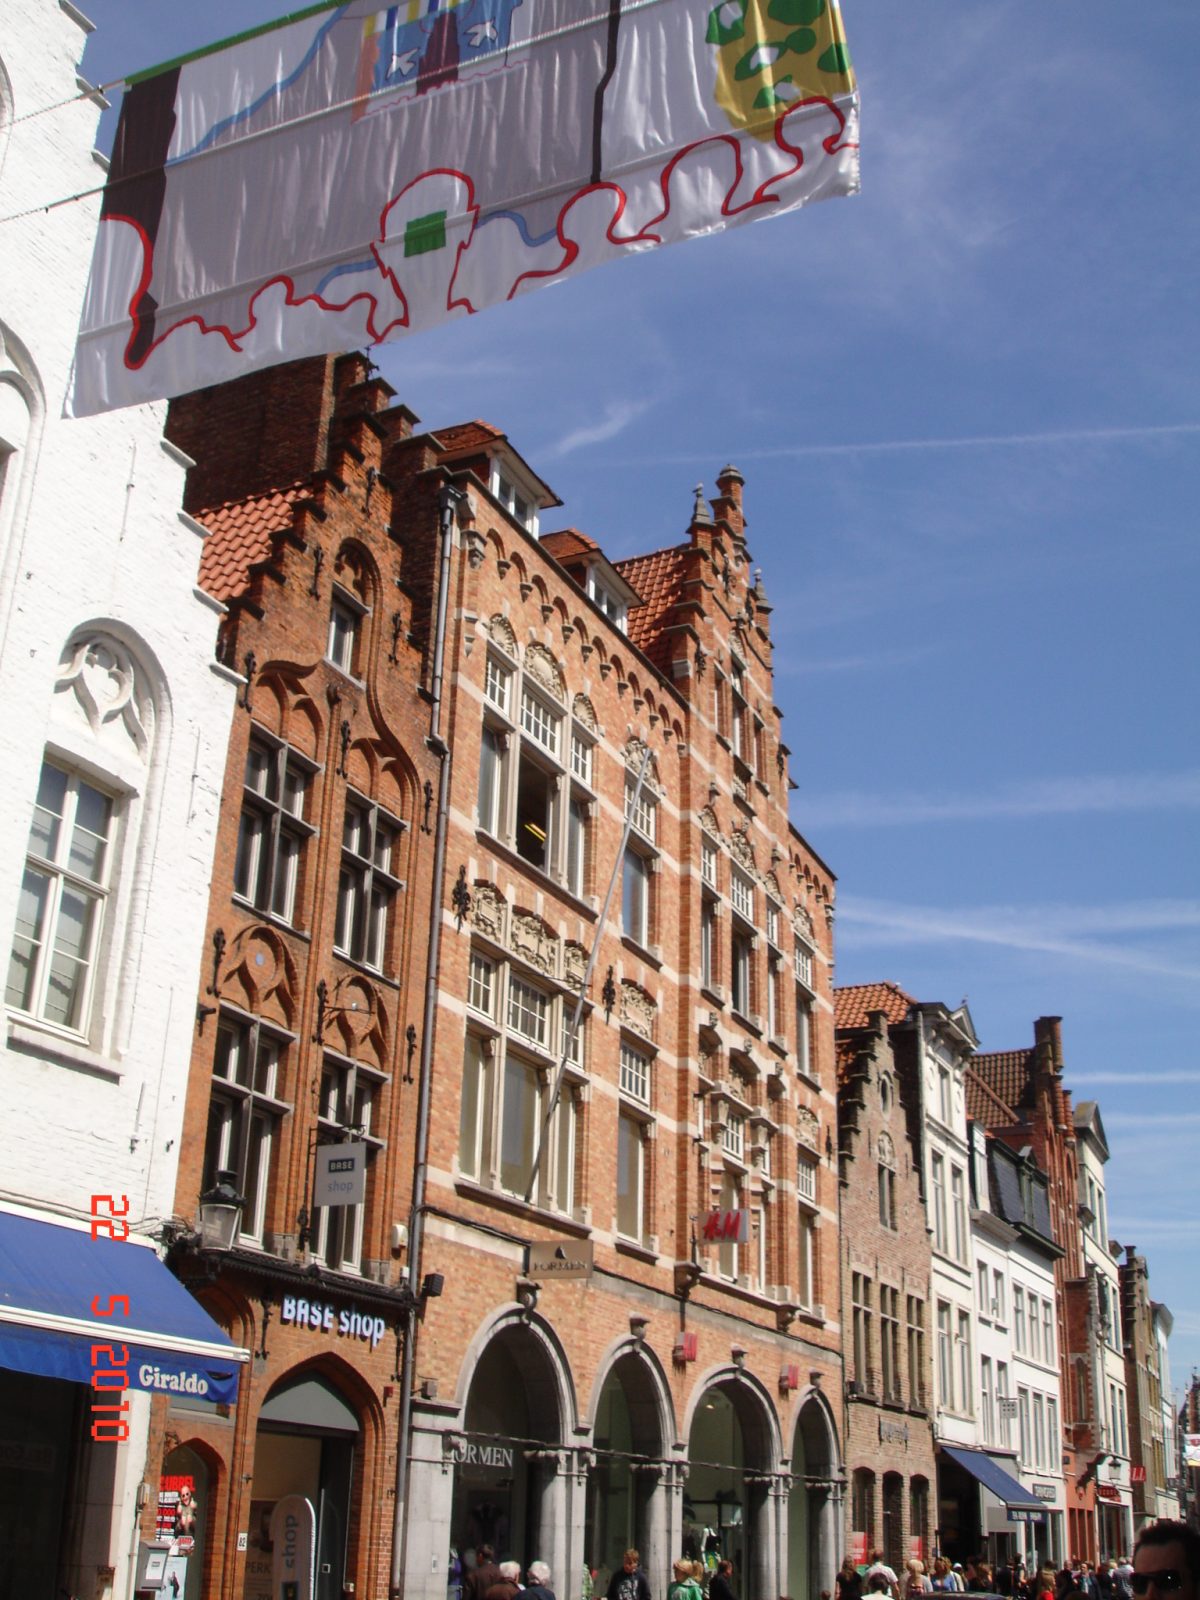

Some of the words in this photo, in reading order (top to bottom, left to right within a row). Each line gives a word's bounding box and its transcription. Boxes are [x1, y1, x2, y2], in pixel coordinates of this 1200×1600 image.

[330, 1160, 353, 1171] BASE
[328, 1180, 353, 1194] shop
[703, 1211, 741, 1241] H&M
[533, 1261, 588, 1273] FORMEN
[282, 1297, 334, 1329] BASE
[340, 1304, 385, 1348] shop
[139, 1364, 209, 1395] Giraldo
[454, 1443, 514, 1468] ORMEN
[282, 1514, 298, 1568] shop
